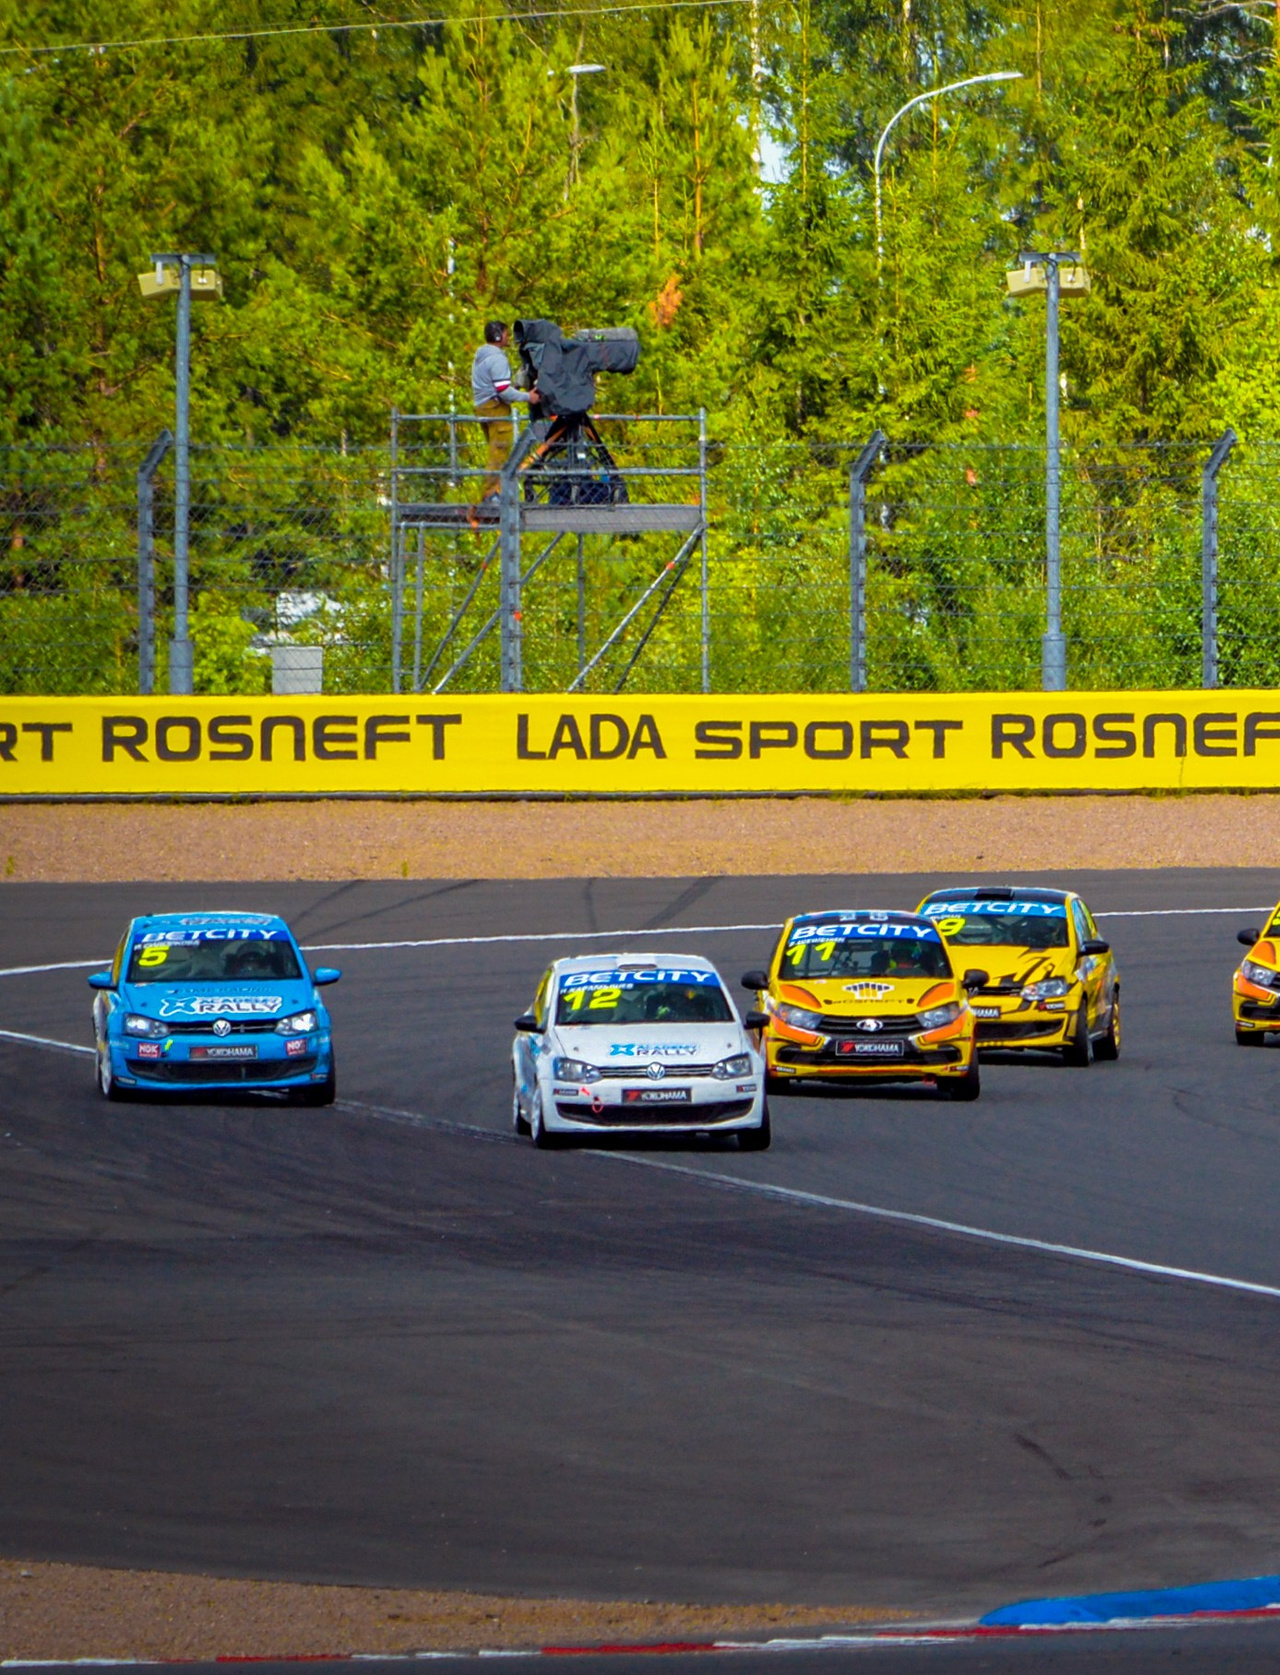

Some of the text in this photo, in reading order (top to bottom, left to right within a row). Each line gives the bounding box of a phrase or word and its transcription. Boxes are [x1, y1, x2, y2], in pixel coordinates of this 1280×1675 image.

[102, 714, 463, 763] ROSNEFT
[517, 713, 667, 761] LADA
[694, 720, 964, 761] SPORT
[924, 901, 1062, 916] BETCITY
[142, 928, 279, 942] BETCITY
[790, 923, 935, 941] BETCITY
[138, 945, 170, 967] 5
[786, 940, 837, 966] 11
[564, 970, 713, 988] BETCITY
[199, 1003, 278, 1013] RALLY
[563, 988, 622, 1011] 12
[206, 1047, 254, 1057] YOKOHAMA
[641, 1090, 687, 1101] YOKOHAMA
